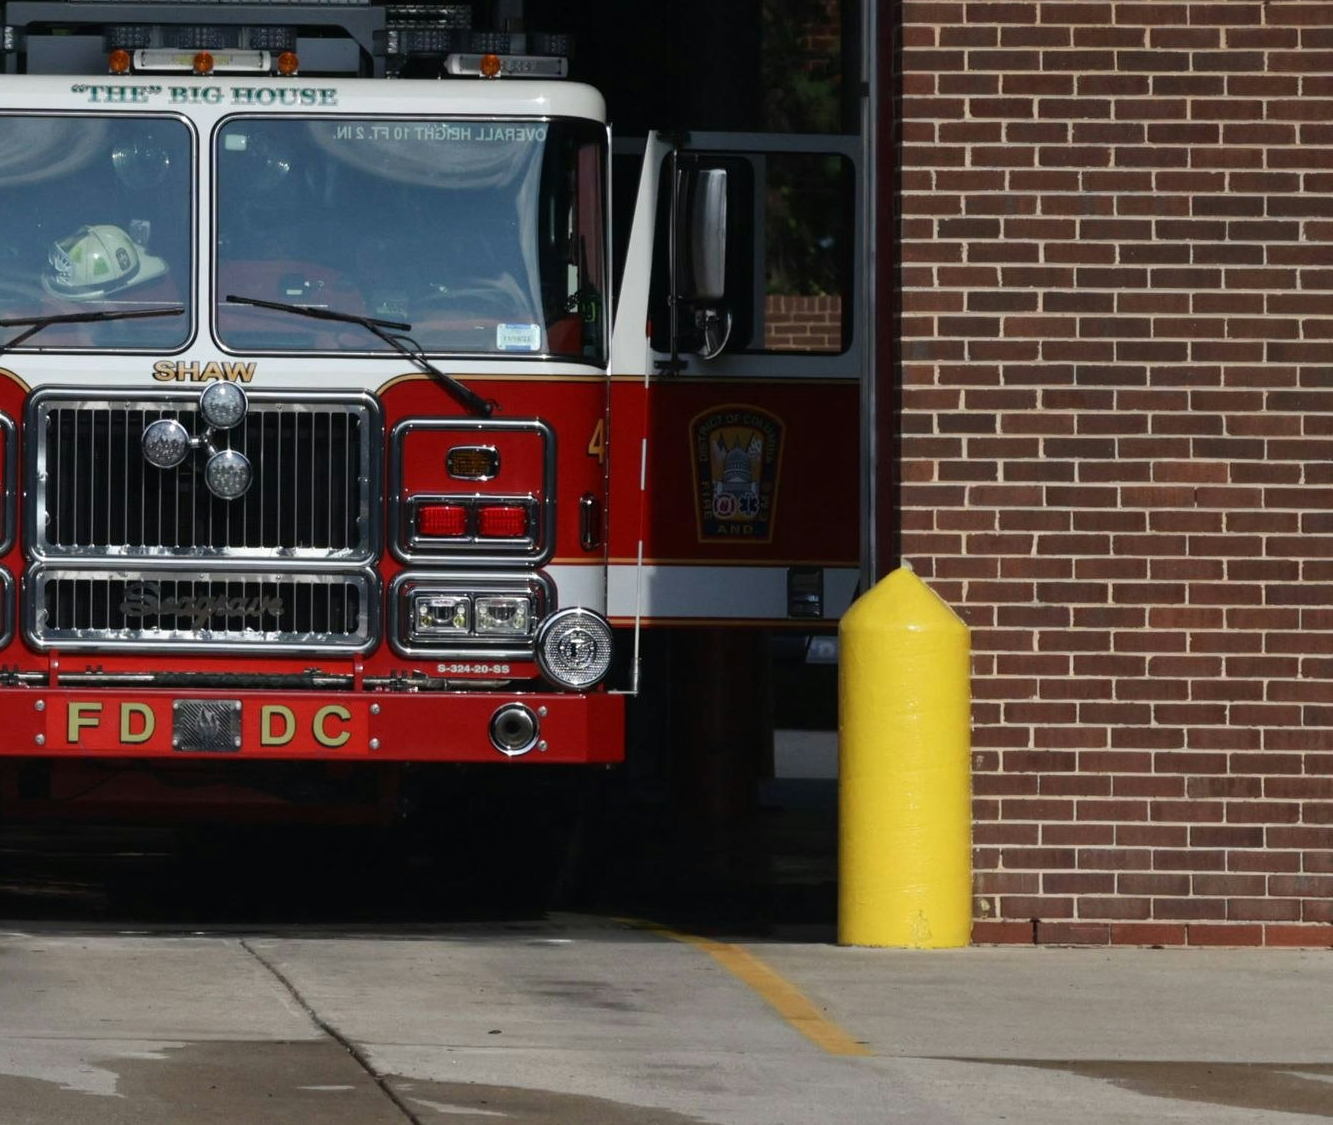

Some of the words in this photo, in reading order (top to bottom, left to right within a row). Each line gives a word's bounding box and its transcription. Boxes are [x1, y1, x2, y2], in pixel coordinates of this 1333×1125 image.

[168, 86, 225, 105] BIG
[230, 86, 337, 106] HOUSE
[152, 360, 258, 383] SHAW
[588, 418, 606, 464] 4
[717, 524, 754, 535] AND
[67, 701, 157, 744] FD
[260, 703, 353, 747] DC
